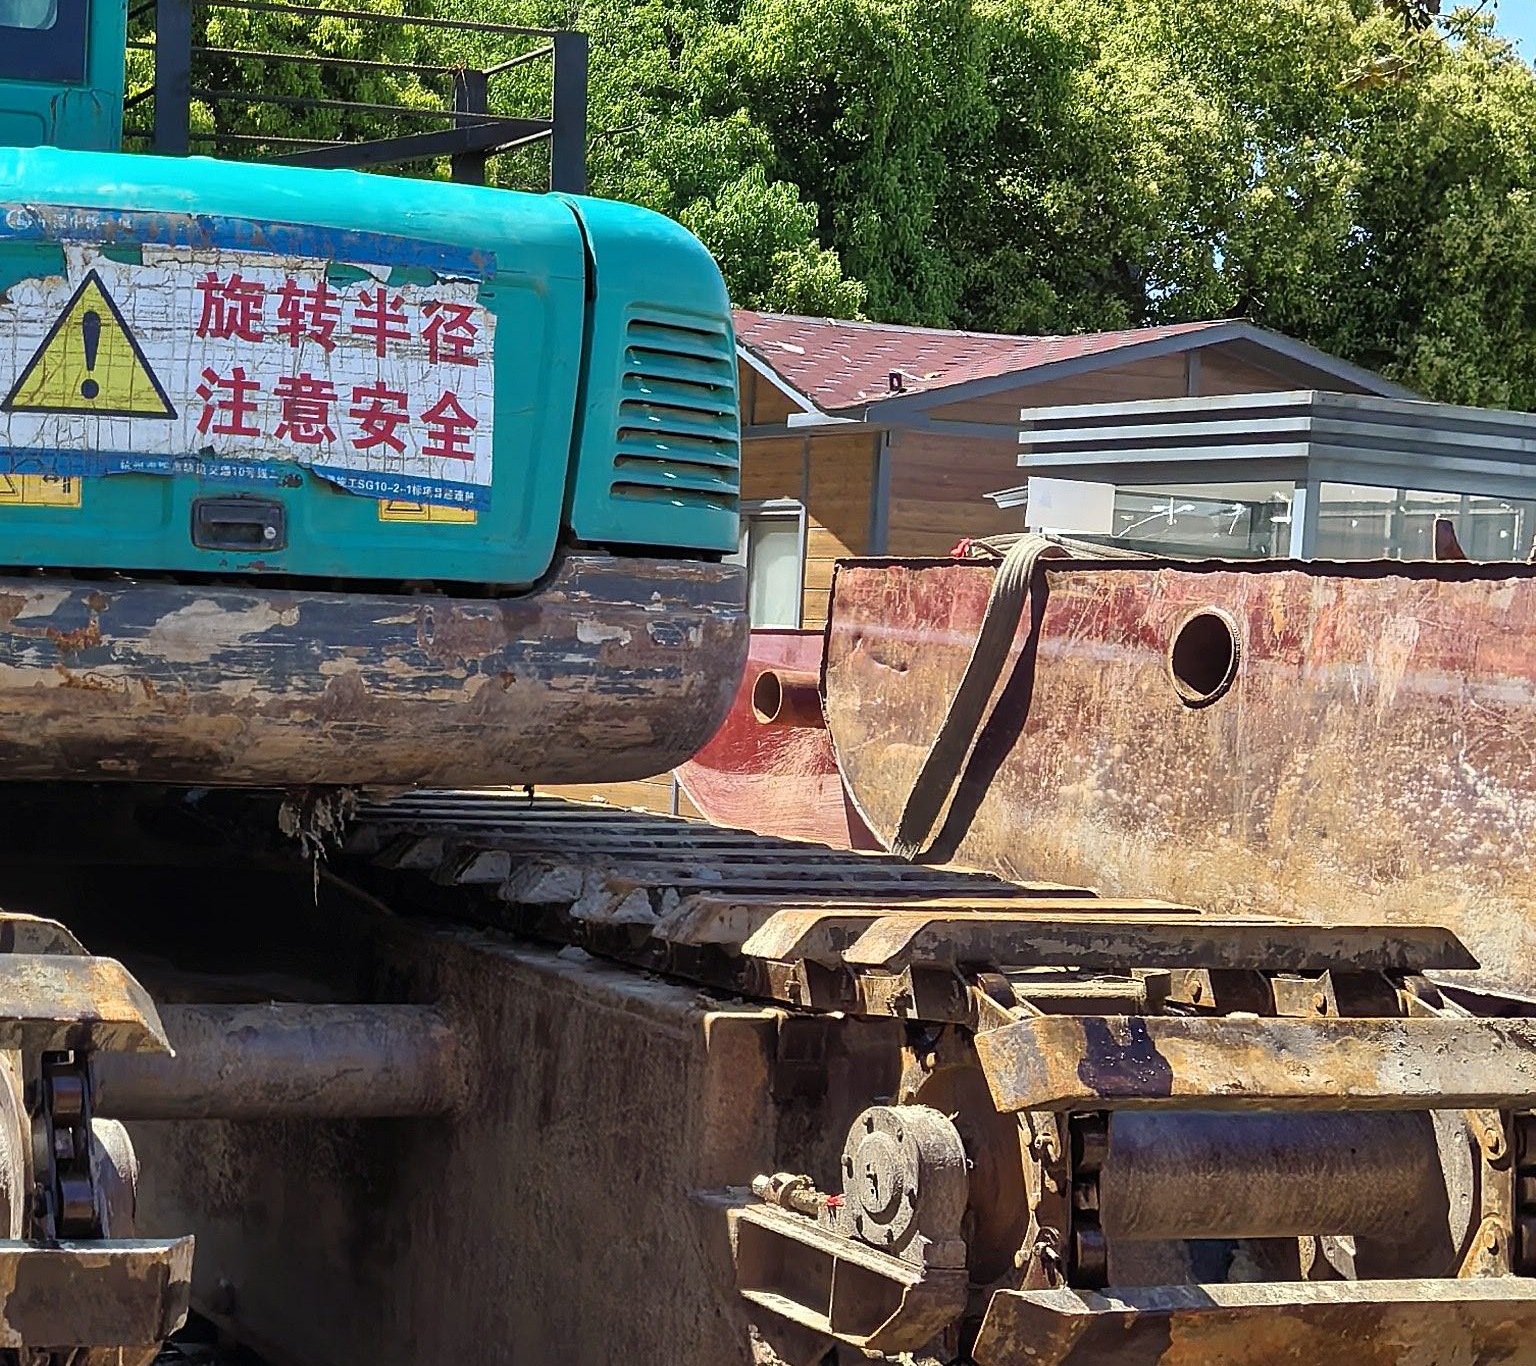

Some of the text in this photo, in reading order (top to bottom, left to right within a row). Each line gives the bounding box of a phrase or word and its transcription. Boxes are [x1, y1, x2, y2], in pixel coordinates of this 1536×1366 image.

[195, 272, 479, 367] 旋转半径
[195, 367, 478, 461] 注意安全
